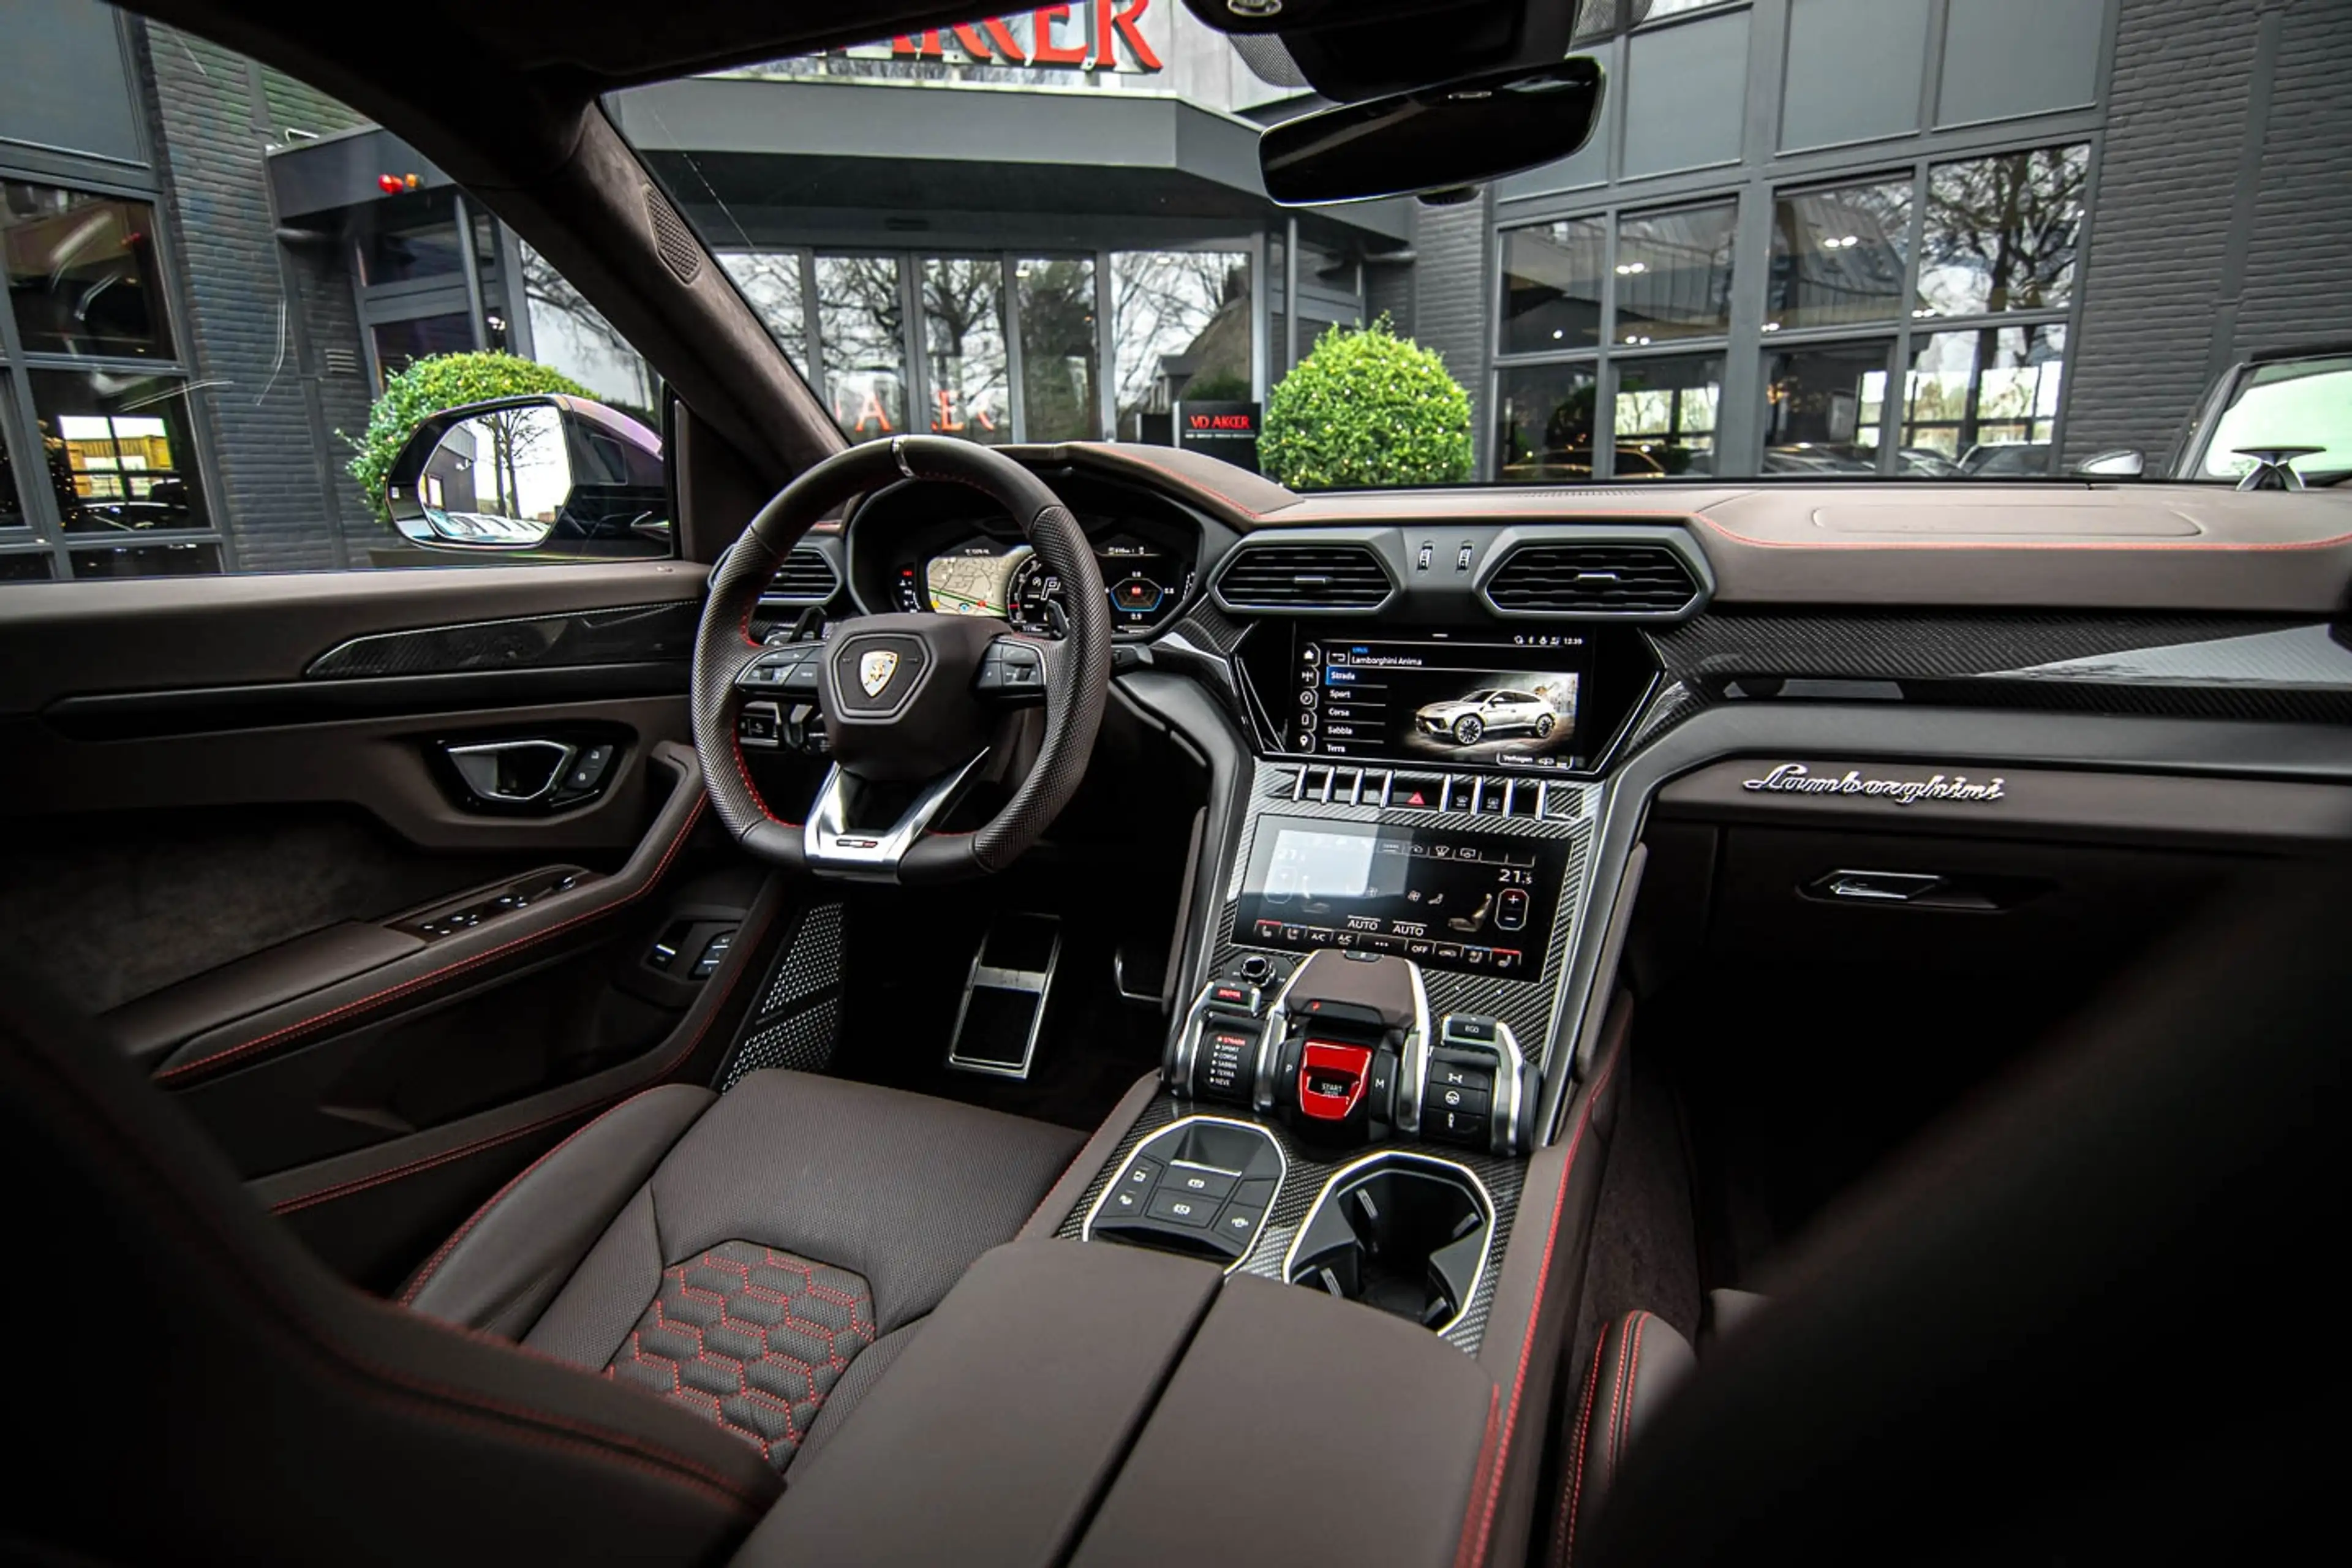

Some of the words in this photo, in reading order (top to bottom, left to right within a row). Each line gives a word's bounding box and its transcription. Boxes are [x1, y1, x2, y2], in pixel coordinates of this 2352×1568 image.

[1351, 656, 1397, 666] Lamborghini
[1330, 671, 1355, 680] Strada
[1329, 689, 1351, 699] Sport
[1328, 707, 1350, 717] Corsa
[1327, 725, 1353, 735] Sabbia
[1326, 743, 1346, 753] Terra
[1743, 763, 2005, 805] Lamborghini
[1348, 919, 1378, 930] AUTO
[1392, 924, 1424, 937] AUTO
[1411, 944, 1428, 954] OFF
[1321, 1082, 1343, 1092] START
[1375, 1079, 1385, 1088] M
